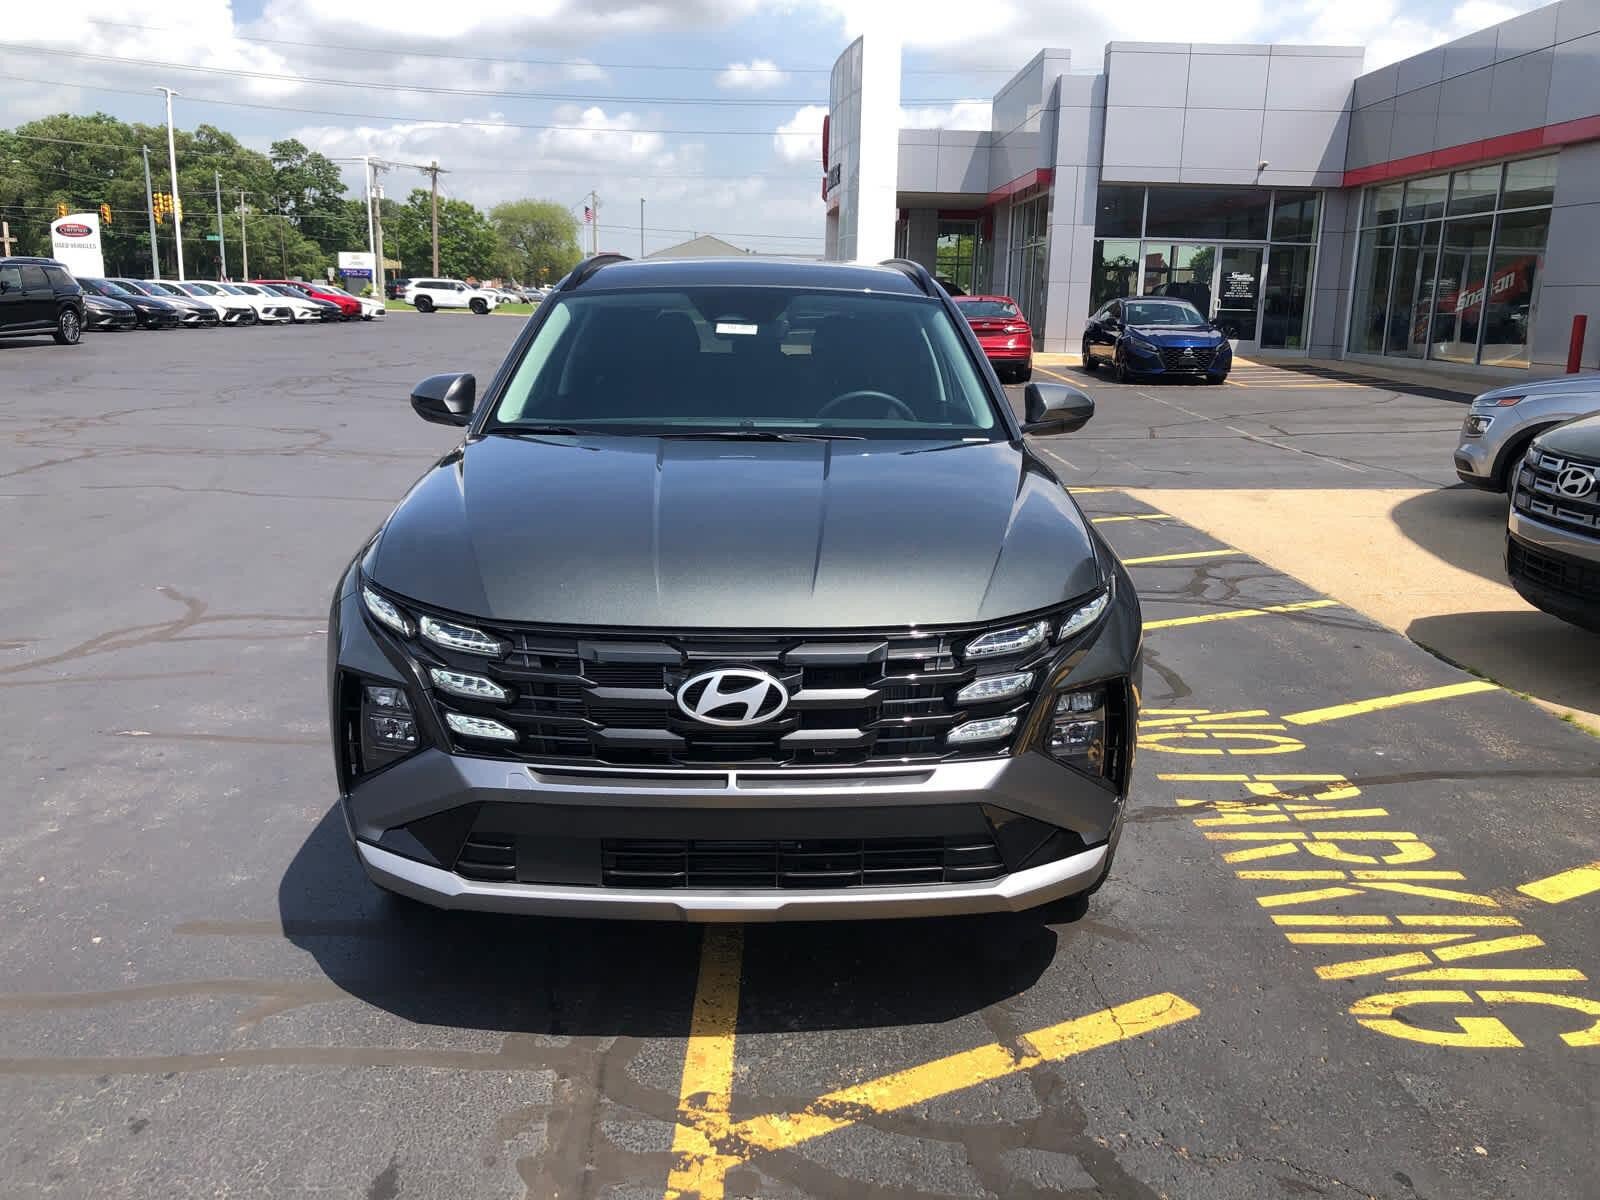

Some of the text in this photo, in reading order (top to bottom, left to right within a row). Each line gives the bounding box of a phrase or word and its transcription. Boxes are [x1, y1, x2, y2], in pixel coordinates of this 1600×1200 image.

[1455, 271, 1515, 312] Sna-on
[1136, 708, 1600, 1048] NO PARKING
